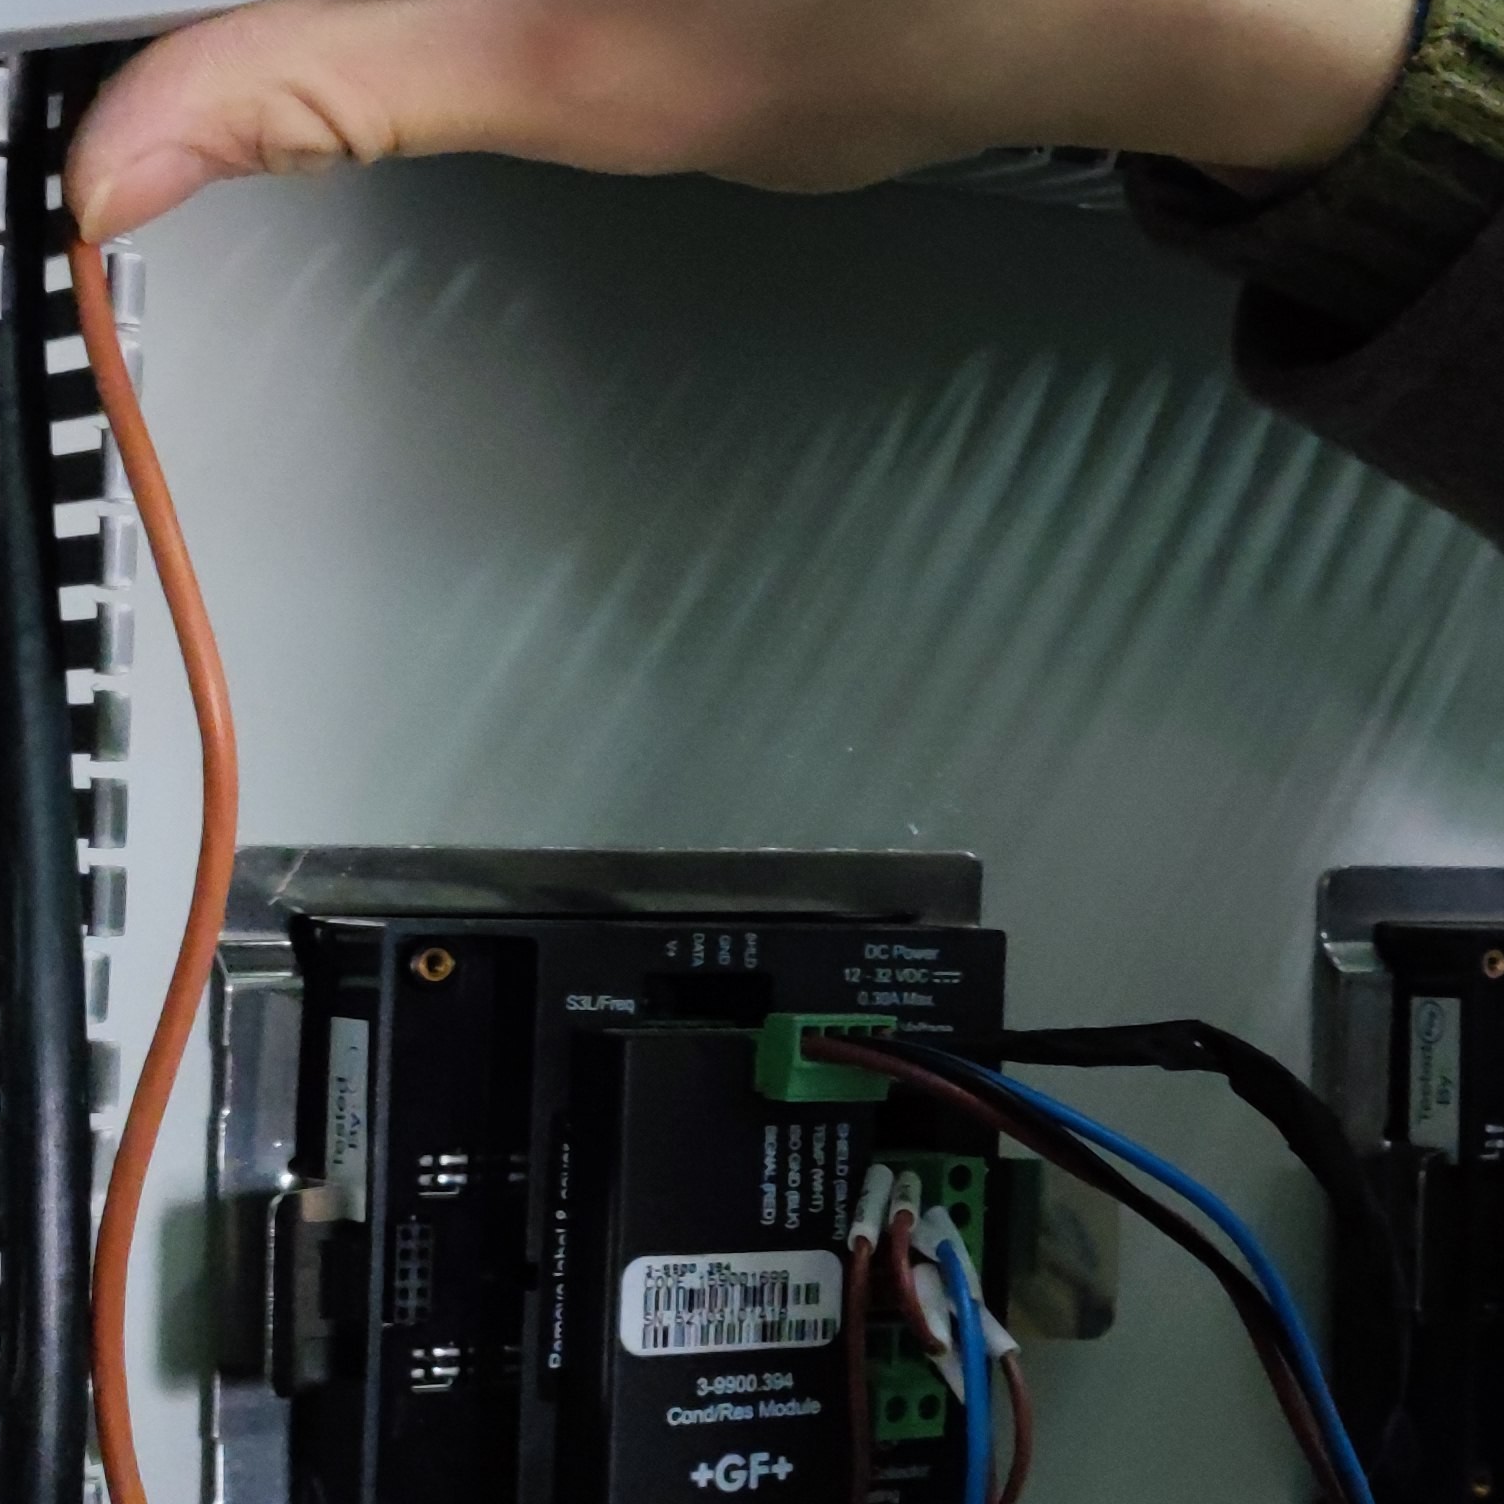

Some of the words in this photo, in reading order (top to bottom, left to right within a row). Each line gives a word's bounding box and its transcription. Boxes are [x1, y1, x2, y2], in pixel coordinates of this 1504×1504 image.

[691, 932, 706, 968] DATA
[718, 934, 733, 967] GND
[864, 943, 890, 961] DC
[892, 943, 942, 961] Power
[844, 967, 862, 984] 12
[895, 967, 930, 984] VDC
[564, 992, 637, 1015] S3L/Freq
[812, 1122, 828, 1166] TEMP
[695, 1371, 796, 1399] 3-9900.394
[665, 1400, 755, 1428] Cond/Res
[758, 1396, 824, 1420] Module
[689, 1450, 796, 1494] +GF+
